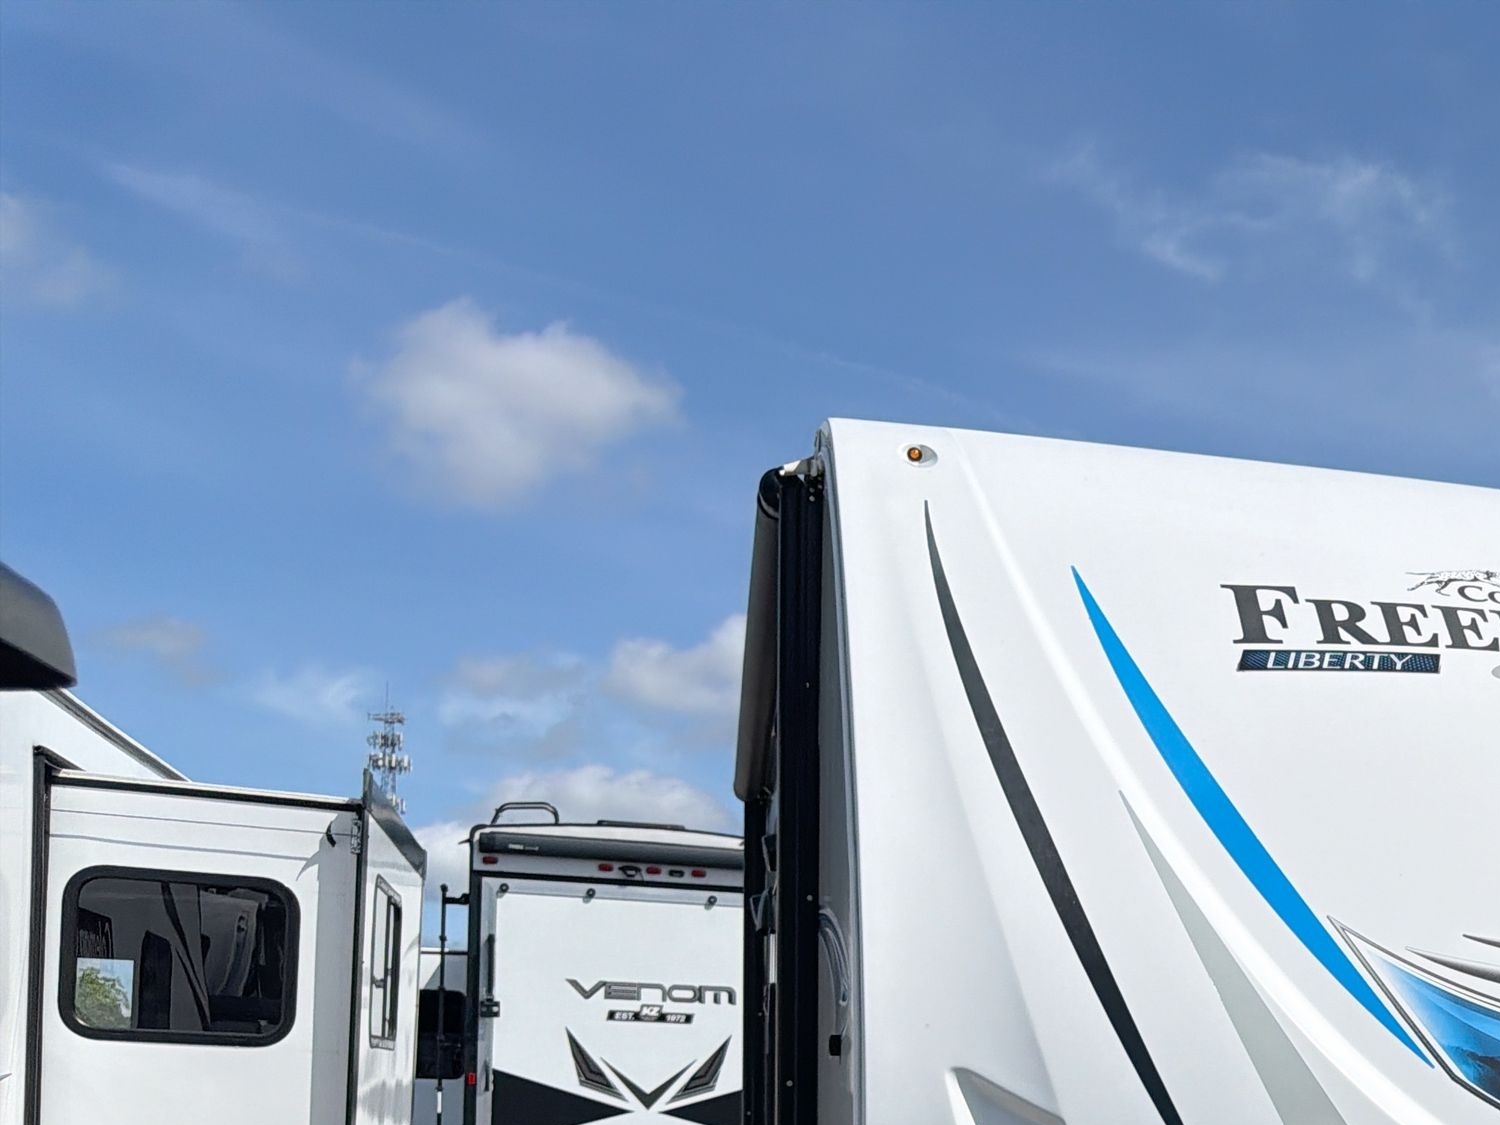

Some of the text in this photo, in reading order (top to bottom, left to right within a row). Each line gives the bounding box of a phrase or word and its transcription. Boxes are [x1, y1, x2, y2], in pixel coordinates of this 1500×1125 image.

[1267, 650, 1414, 672] LIBERTY
[565, 978, 736, 1005] VENOM
[614, 1012, 635, 1020] EST.
